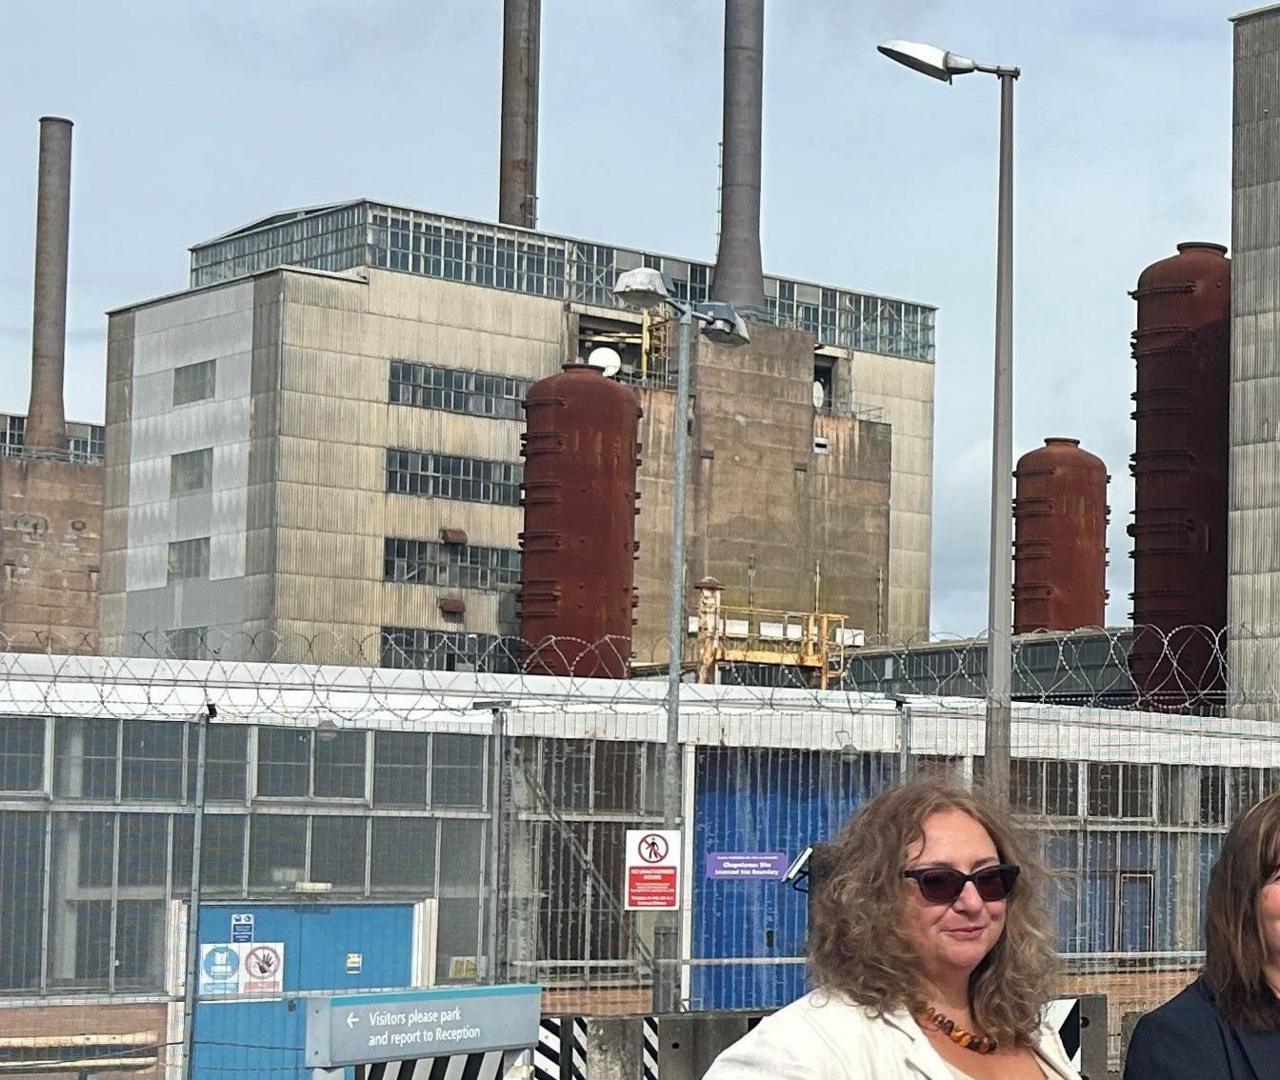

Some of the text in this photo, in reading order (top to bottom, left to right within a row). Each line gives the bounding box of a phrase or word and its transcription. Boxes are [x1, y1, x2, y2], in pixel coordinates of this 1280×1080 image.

[369, 1006, 462, 1027] Visitors please park
[368, 1024, 481, 1047] and report to Reception
